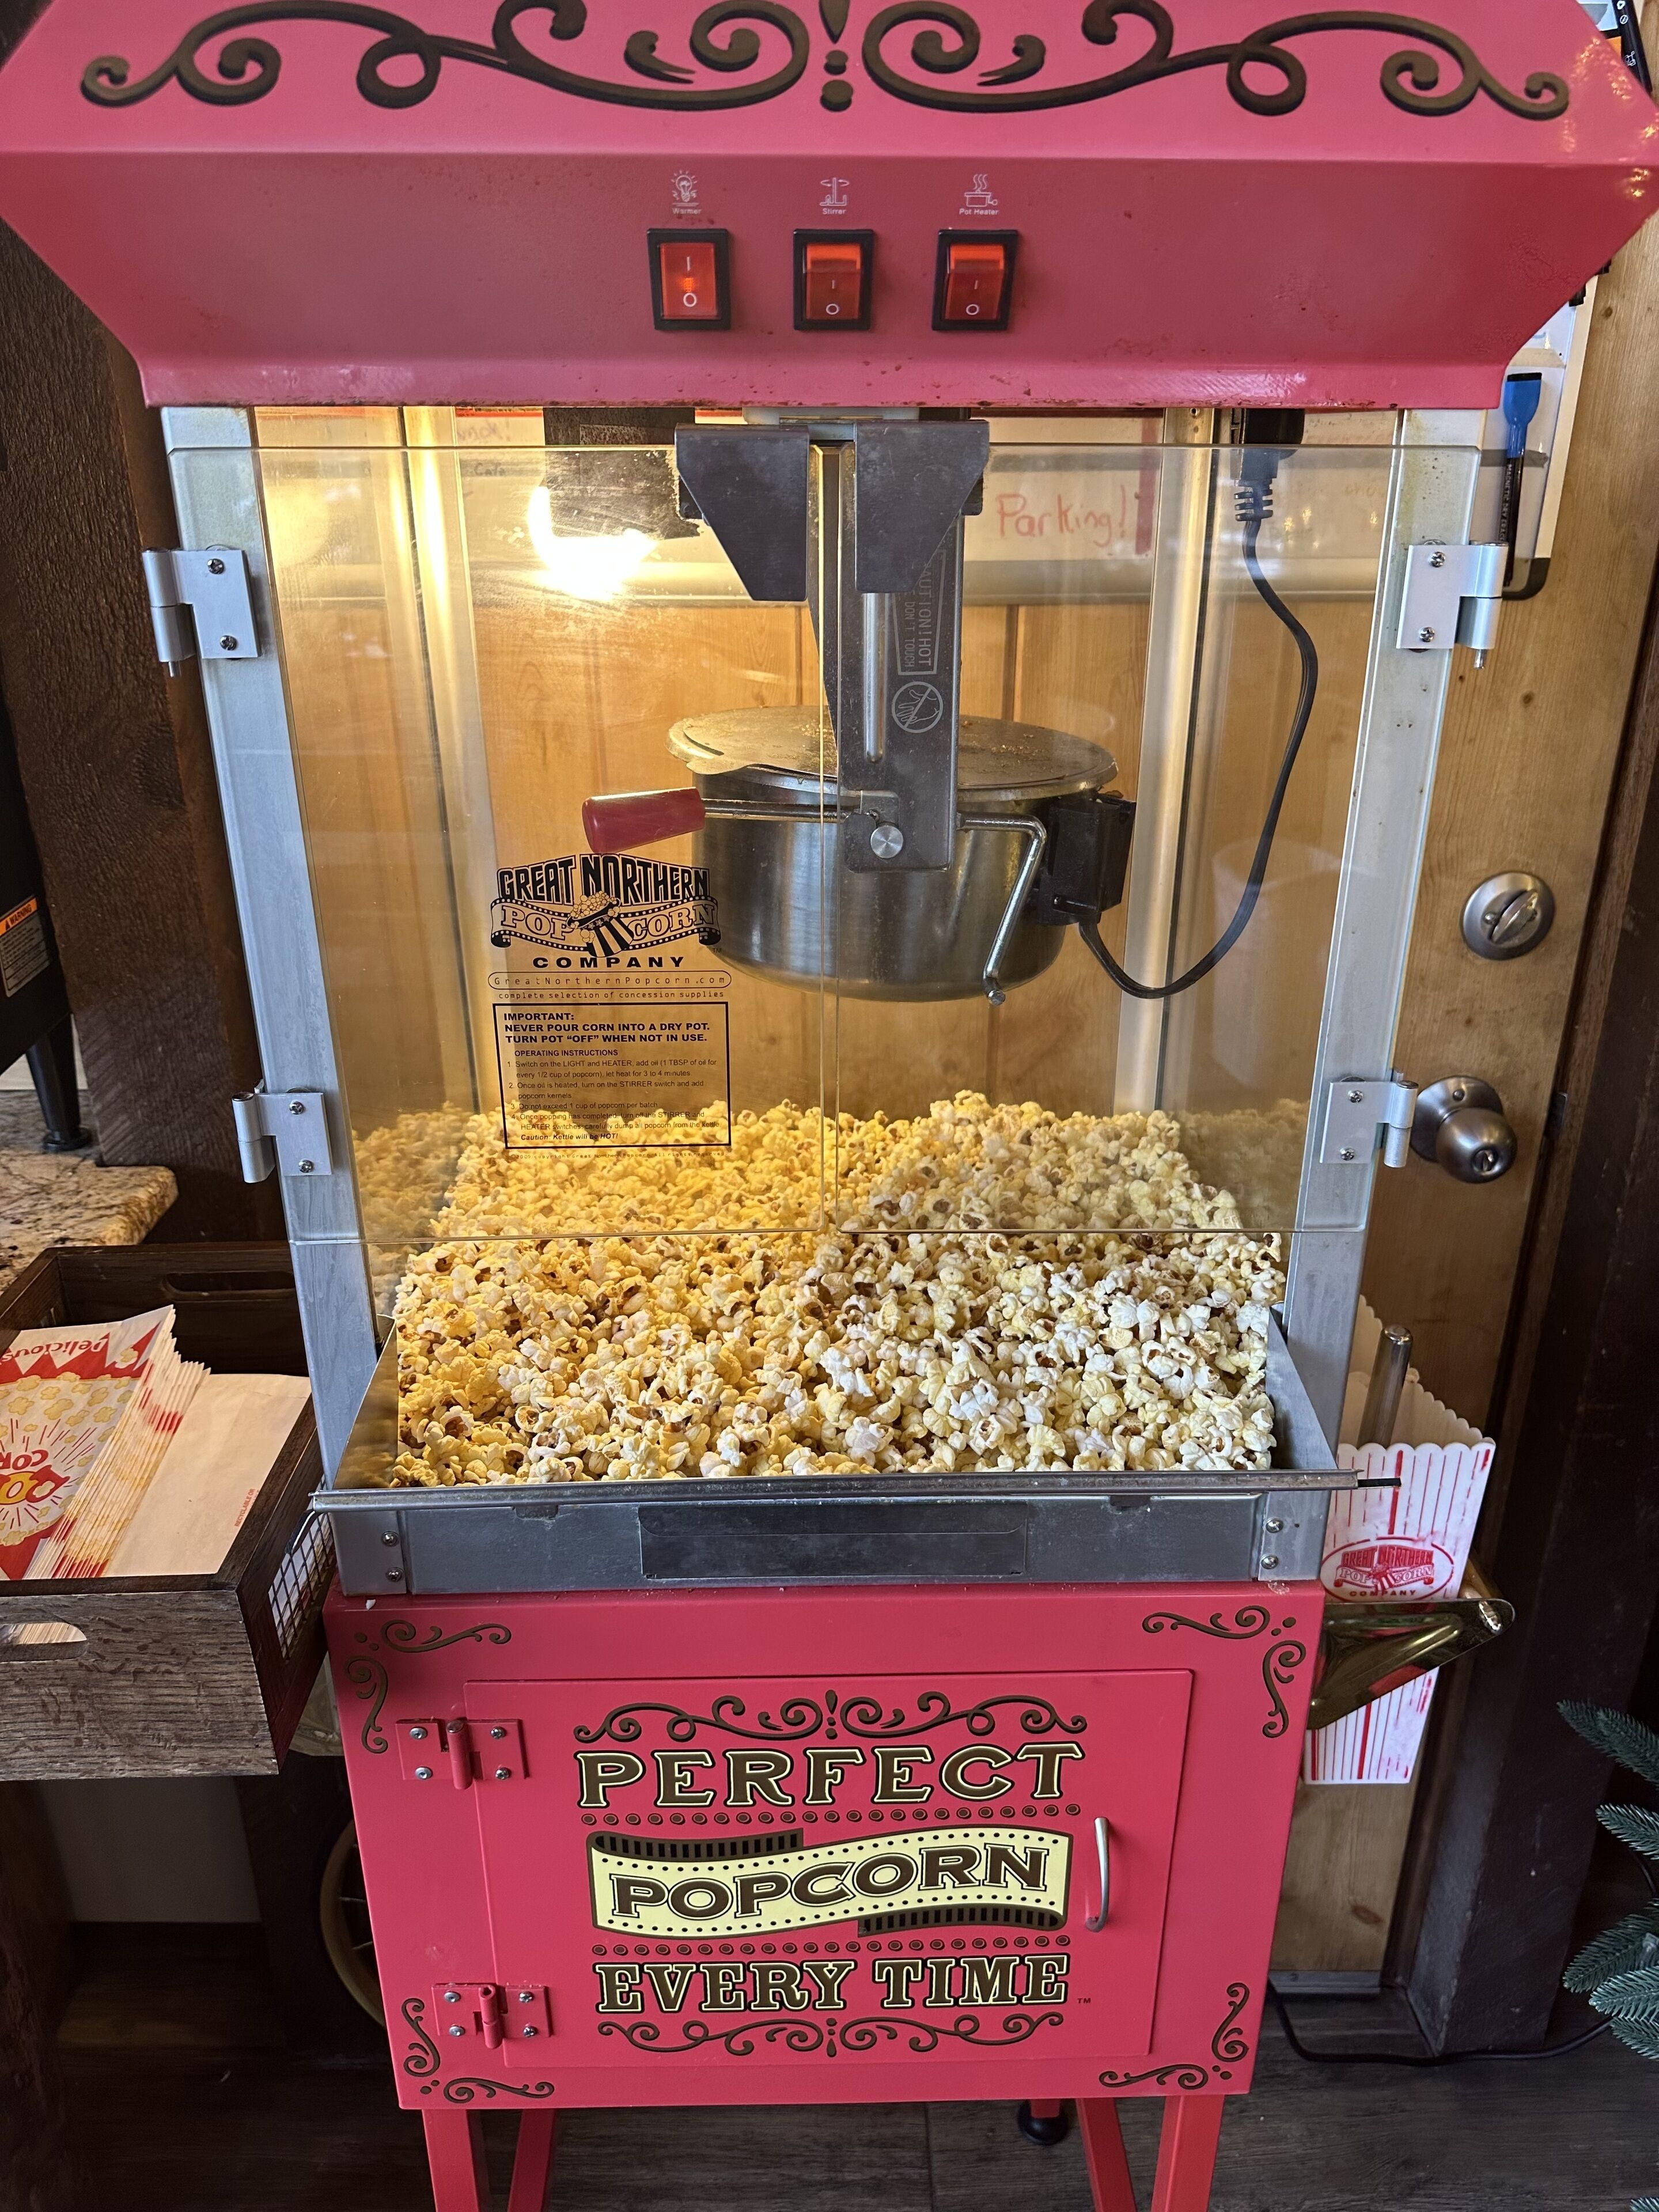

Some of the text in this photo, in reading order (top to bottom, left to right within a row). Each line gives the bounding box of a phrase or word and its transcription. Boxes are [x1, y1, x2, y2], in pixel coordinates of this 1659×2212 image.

[1502, 464, 1513, 502] MAGNETIC
[996, 484, 1127, 547] Parking!
[918, 562, 932, 666] AUTION! HOT
[904, 638, 915, 667] TOUCH
[497, 853, 710, 906] GREAT NORTHERN
[501, 905, 574, 941] POP
[627, 904, 714, 941] CORN
[533, 957, 684, 968] COMPANY
[494, 976, 725, 986] GreatNorthernPopcorn.com
[680, 991, 724, 999] supplies
[503, 1013, 574, 1021] IMPORTANT:
[547, 1024, 579, 1032] POUR
[618, 1023, 645, 1031] INTO
[505, 1035, 537, 1043] TURN
[1, 1338, 109, 1362] Delicious
[574, 1741, 1085, 1809] PERFECT
[609, 1843, 1050, 1919] POPCORN
[593, 1960, 854, 2014] EVERY
[873, 1953, 1070, 2010] TIME
